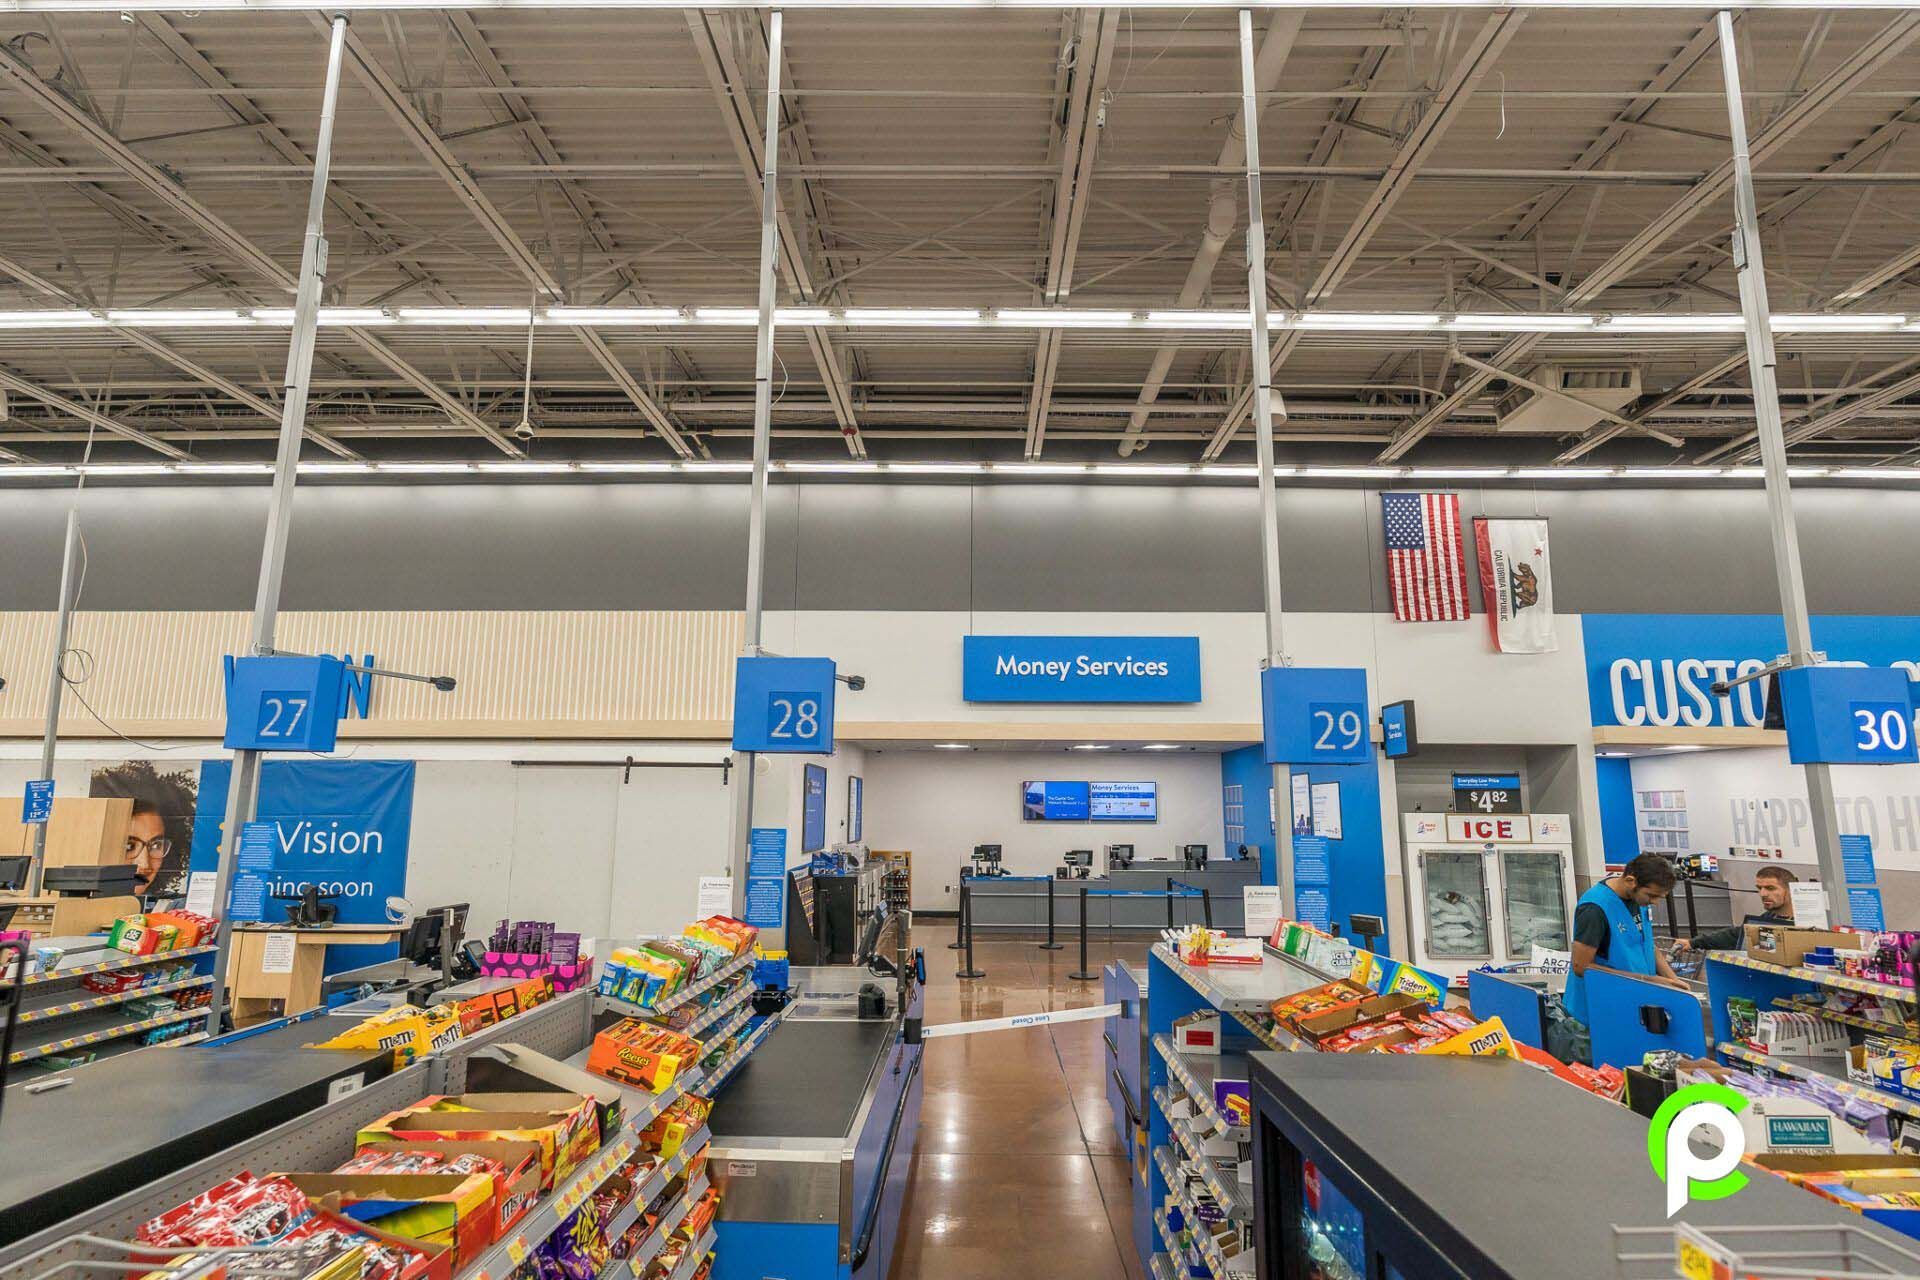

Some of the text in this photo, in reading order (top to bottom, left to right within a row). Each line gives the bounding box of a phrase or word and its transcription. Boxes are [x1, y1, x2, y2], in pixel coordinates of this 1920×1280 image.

[995, 655, 1168, 681] Money Services
[259, 698, 308, 737] 27
[770, 699, 818, 739] 28
[1313, 710, 1361, 750] 29
[1854, 709, 1907, 751] 30
[276, 821, 383, 855] Vision
[1464, 819, 1513, 839] ICE
[1728, 797, 1809, 847] HAPP
[319, 881, 374, 898] soon
[1542, 957, 1572, 967] ARCT
[1399, 976, 1428, 992] Trident
